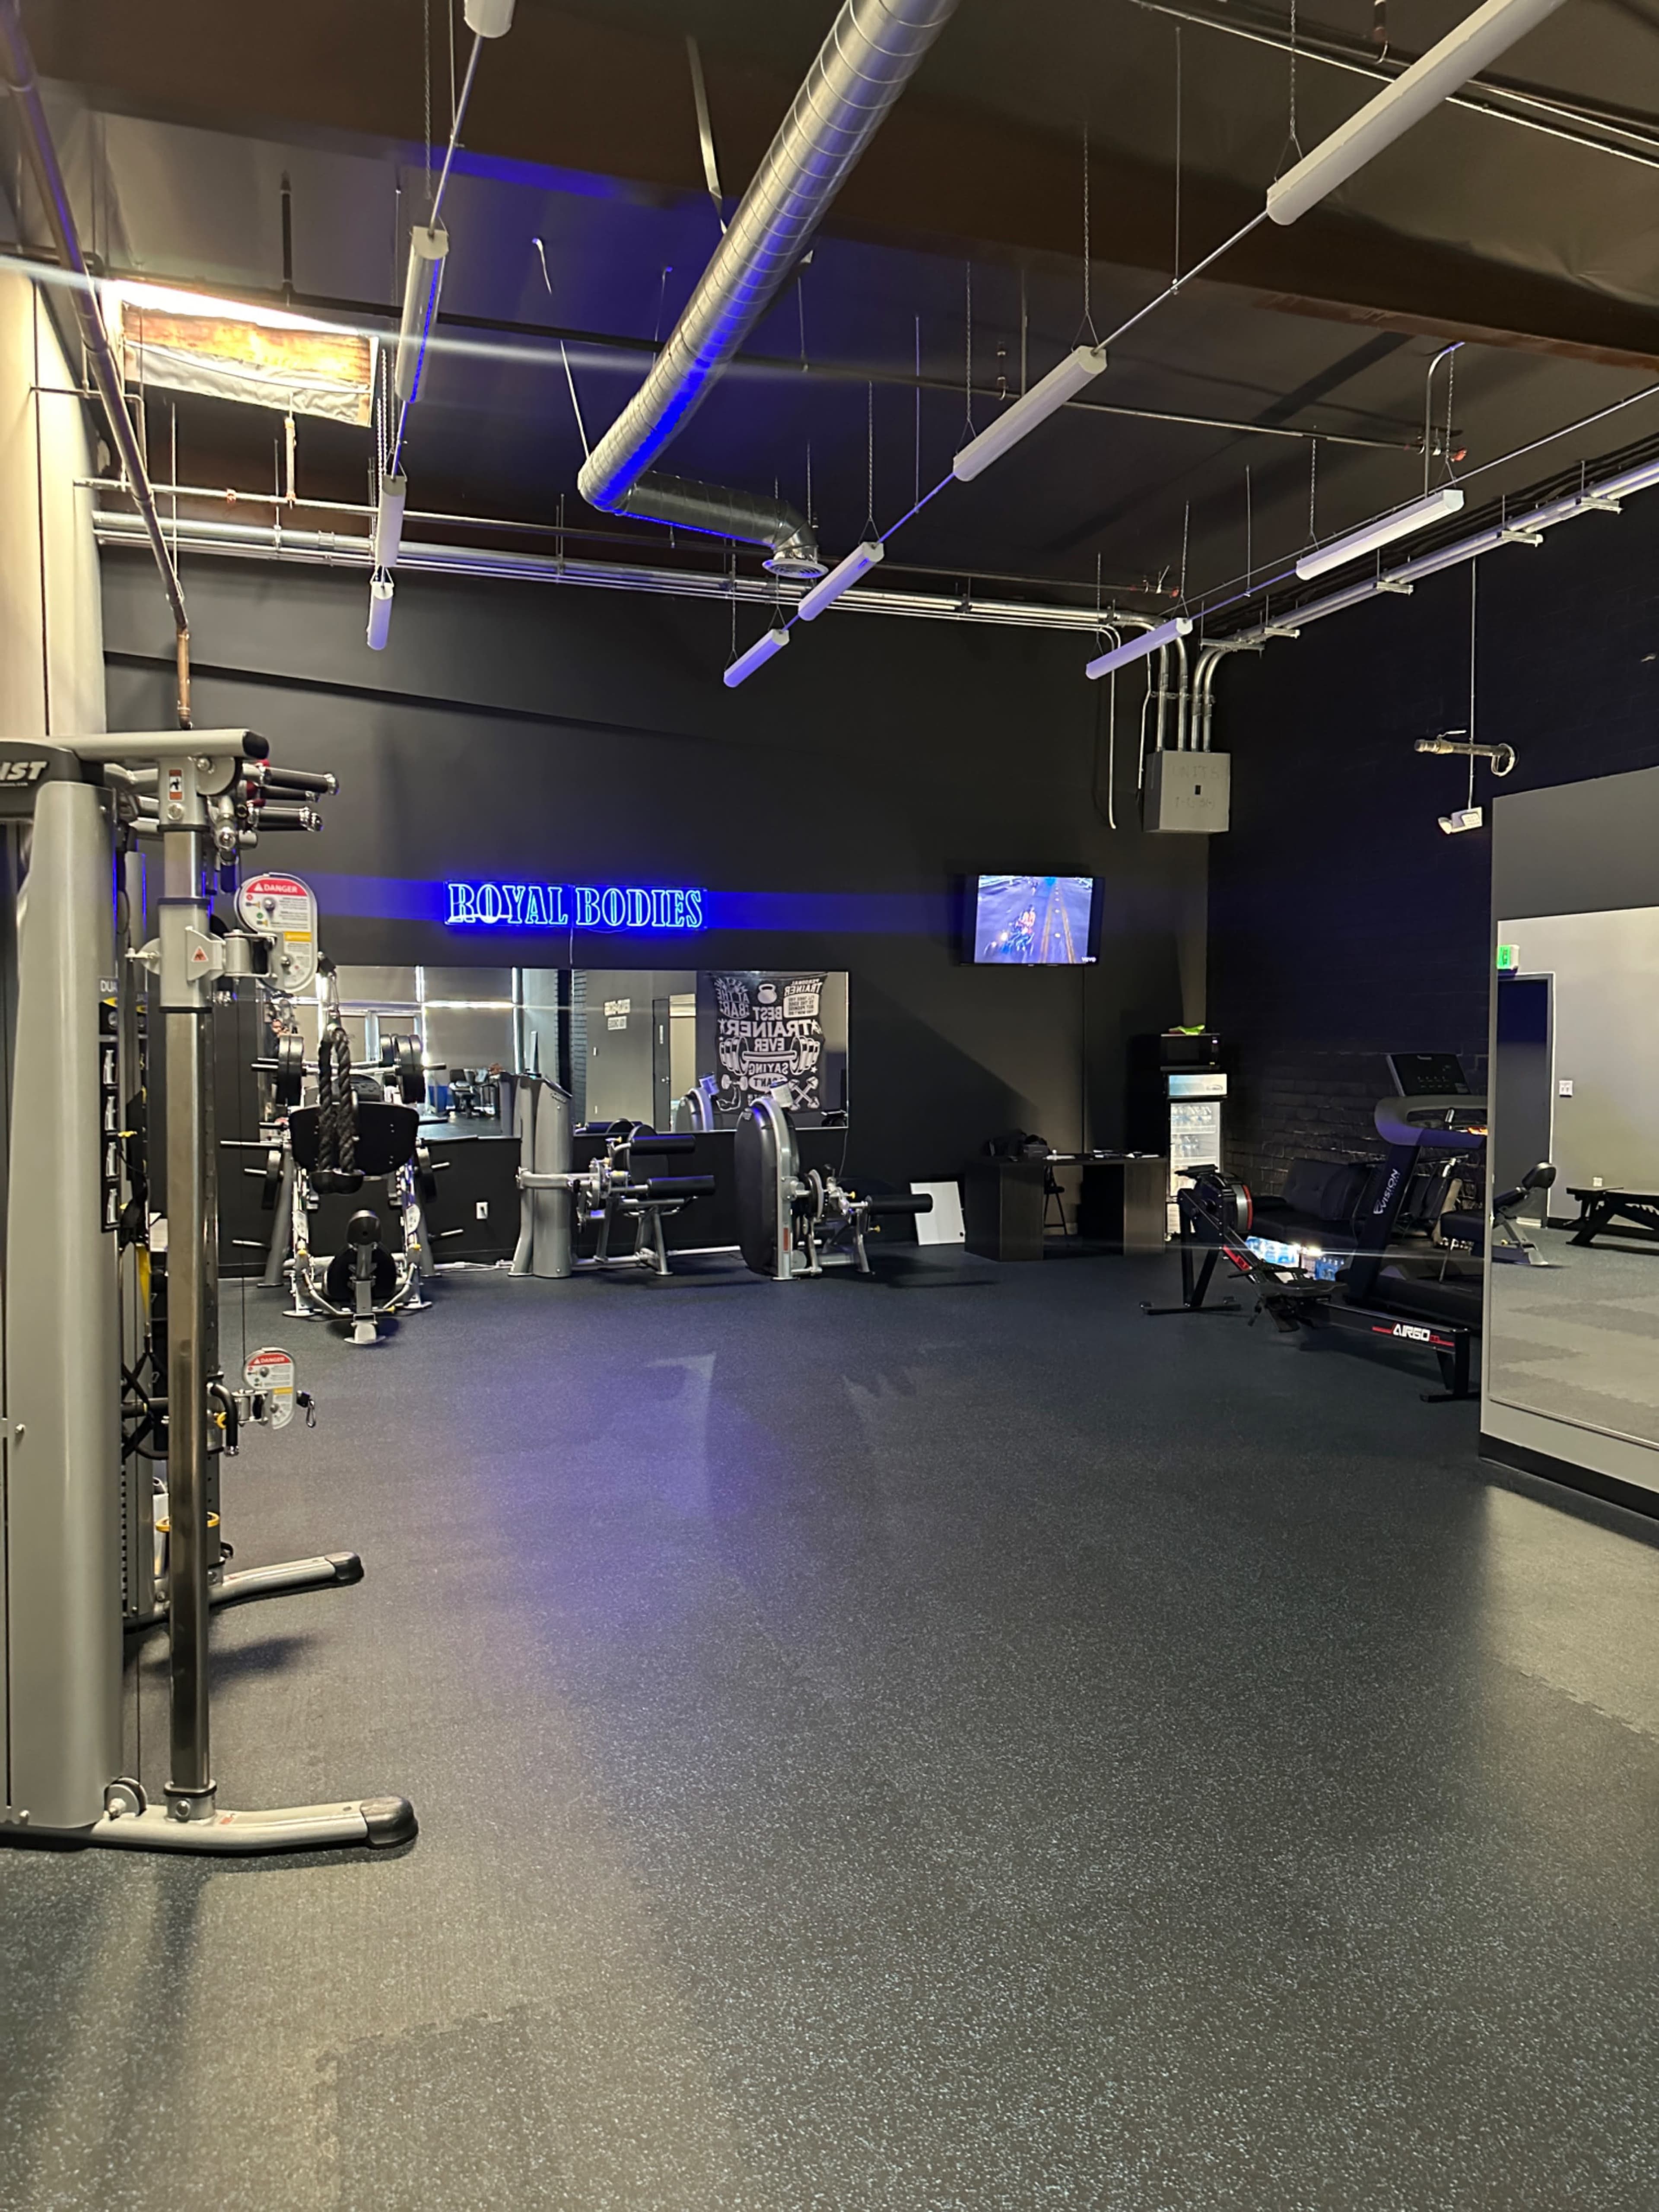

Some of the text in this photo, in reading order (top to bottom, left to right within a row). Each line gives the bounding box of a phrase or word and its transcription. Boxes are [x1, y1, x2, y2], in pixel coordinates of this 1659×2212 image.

[264, 884, 298, 893] DANGER
[448, 884, 703, 927] ROYAL BODIES
[1382, 1169, 1400, 1208] VISION
